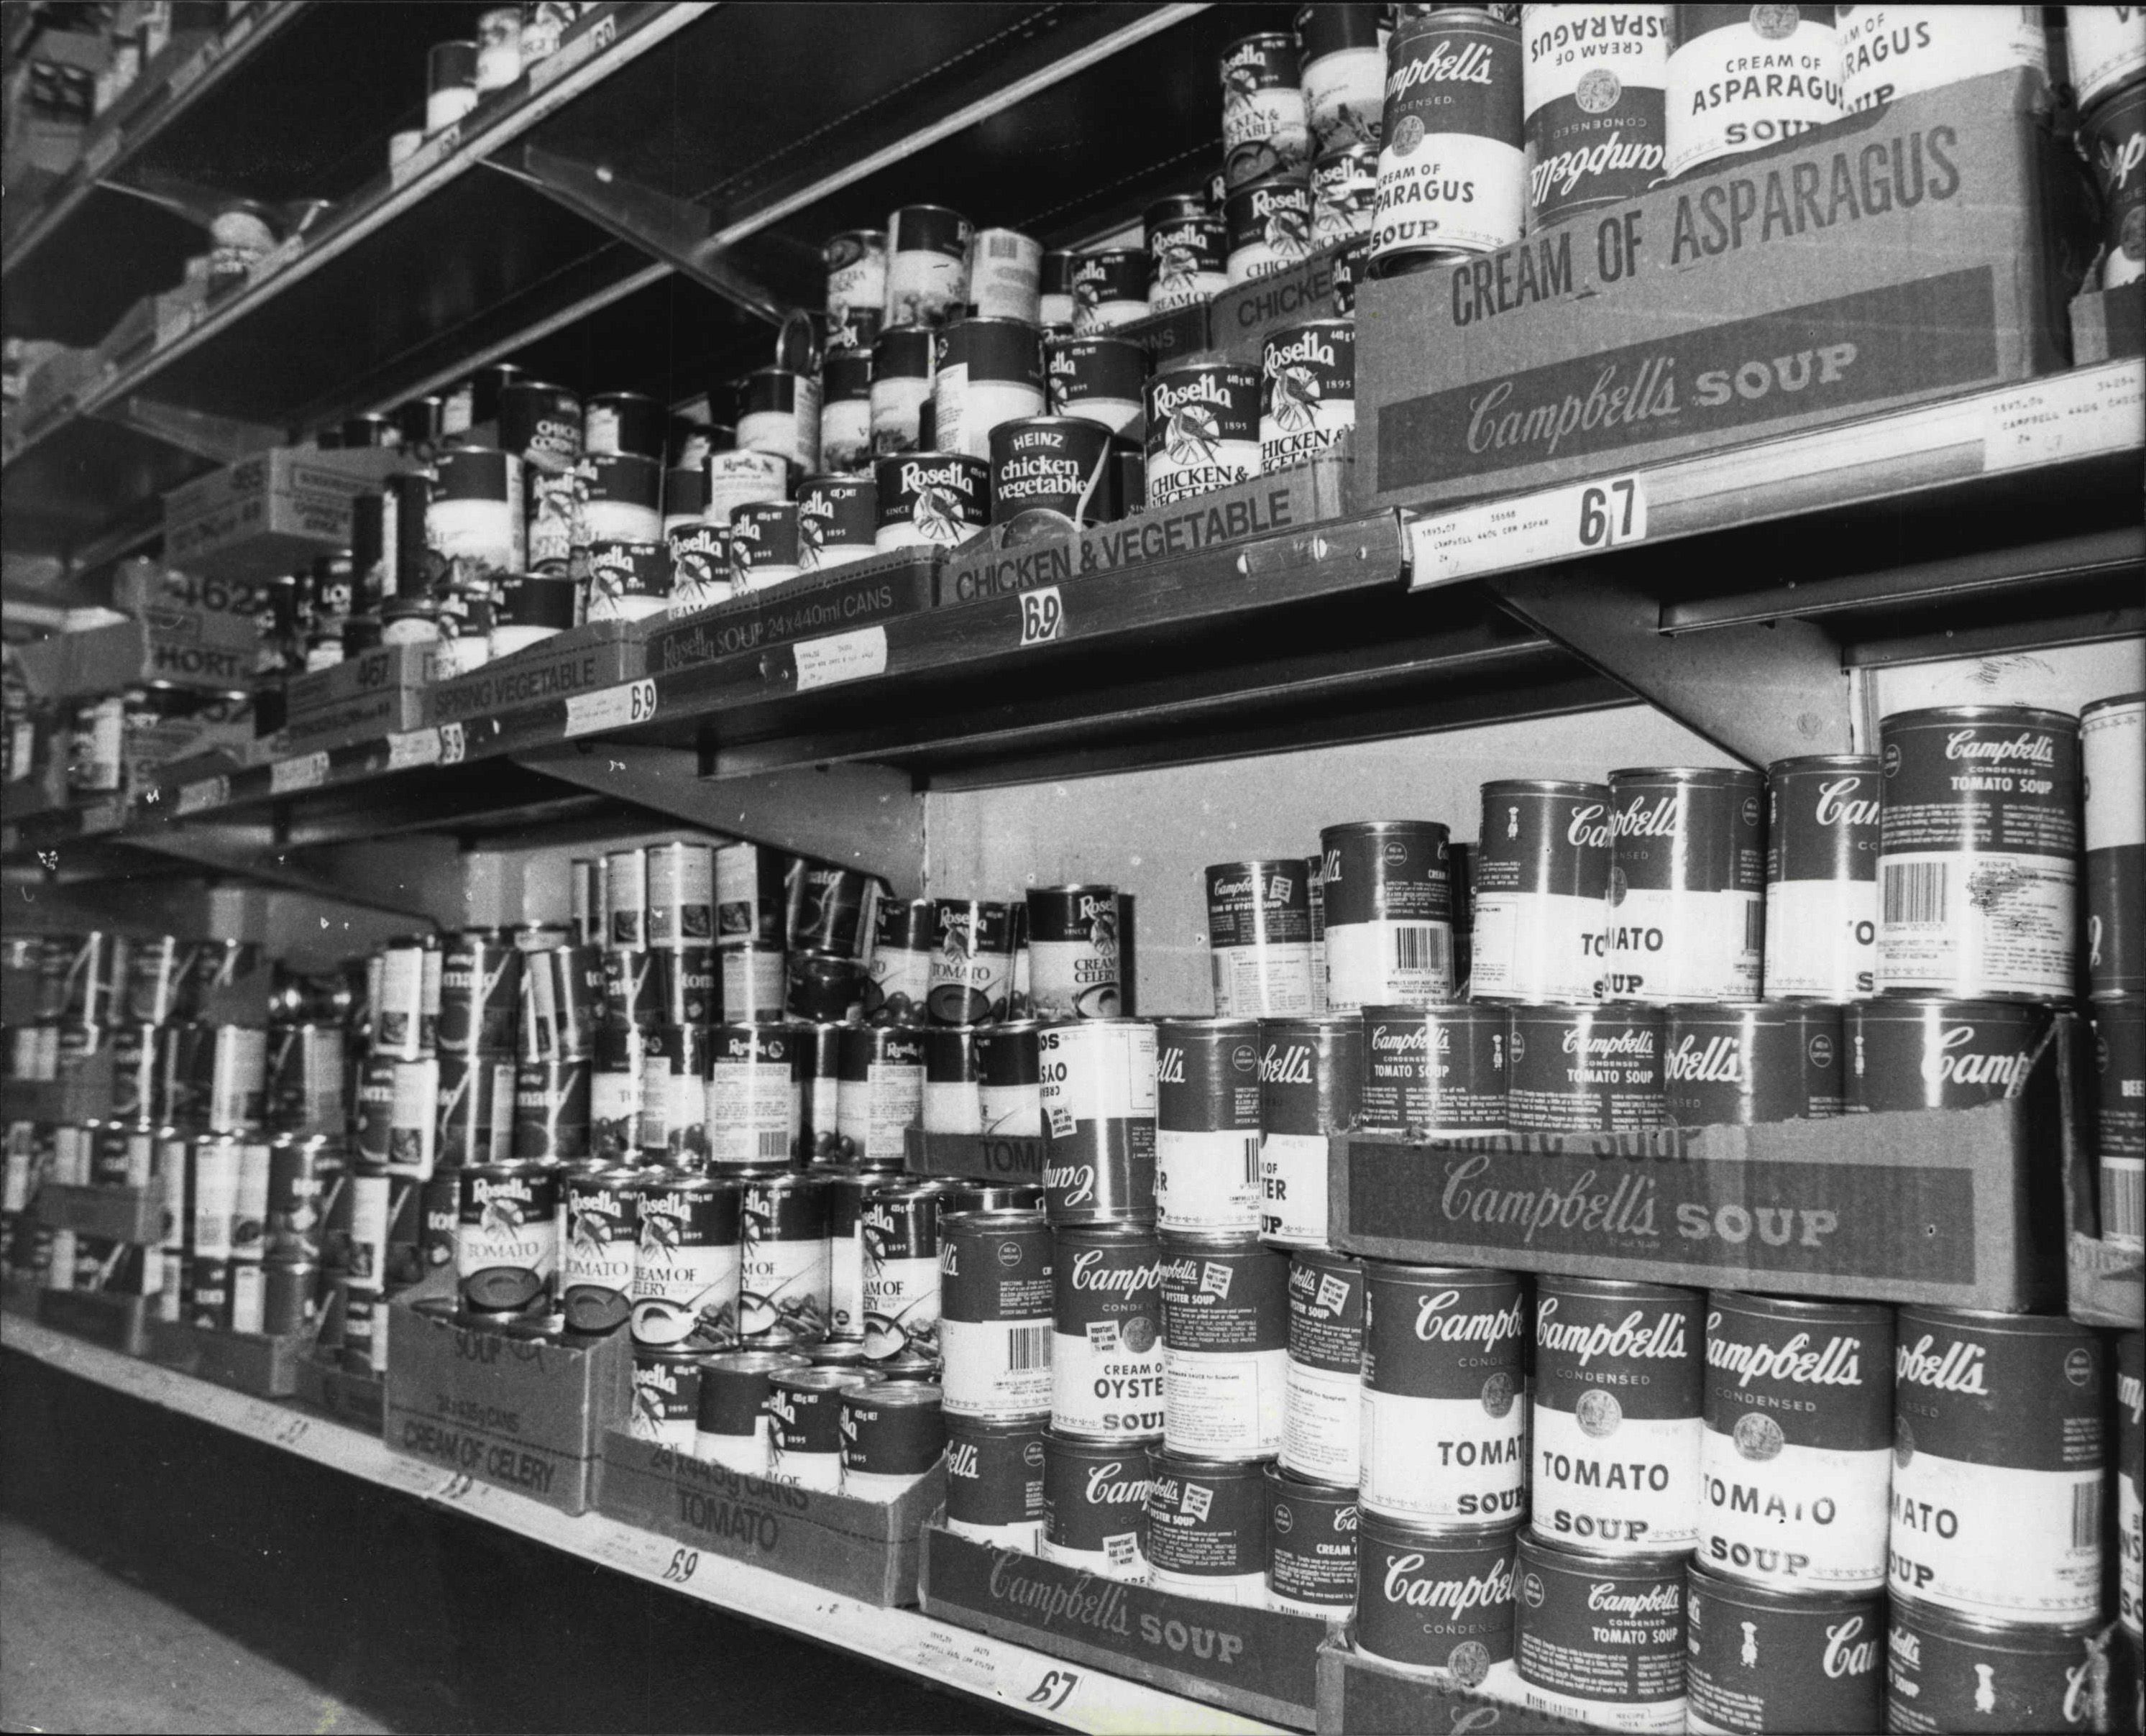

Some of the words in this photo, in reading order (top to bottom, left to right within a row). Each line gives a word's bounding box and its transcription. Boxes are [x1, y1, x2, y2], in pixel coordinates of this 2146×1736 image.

[1865, 12, 1885, 34] OF
[1554, 48, 1574, 67] OF
[1581, 40, 1644, 59] CREAM
[1725, 55, 1794, 73] CREAM
[1801, 55, 1822, 70] OF
[1840, 20, 1932, 83] RAGUS
[1420, 162, 1441, 178] OF
[1374, 180, 1475, 215] PARAGUS
[1151, 224, 1208, 260] Rosella
[1370, 220, 1441, 252] SOUP
[1451, 231, 1574, 328] CREAM
[1596, 209, 1643, 284] OF
[1669, 124, 1961, 266] ASPARAGUS
[1263, 331, 1336, 380] Rosella
[1152, 373, 1233, 423] Rosella
[1326, 380, 1352, 390] 1895
[1466, 357, 1682, 455] Campbell's
[1692, 342, 1858, 406] SOUP
[1013, 431, 1064, 451] HEINZ
[1224, 422, 1247, 431] 1895
[900, 461, 974, 496] Rosella
[1000, 455, 1080, 482] chicken
[1151, 466, 1232, 498] CHICKEN
[1234, 466, 1250, 482] &
[997, 475, 1088, 501] vegetable
[885, 505, 911, 517] SINCE
[1578, 477, 1638, 546] 67
[955, 544, 1073, 605] CHICKEN
[1078, 541, 1099, 575] &
[1101, 487, 1293, 570] VEGETABLE
[843, 585, 894, 619] CANS
[1023, 594, 1060, 642] 69
[492, 656, 597, 705] VEGETABLE
[630, 681, 656, 721] 69
[1944, 728, 2056, 765] Campbell's
[1949, 776, 2014, 793] TOMATO
[2019, 778, 2053, 795] SOUP
[1562, 1027, 1655, 1058] Campbell's
[1374, 1063, 1413, 1079] TOMATO
[1418, 1065, 1450, 1079] SOUP
[1566, 1068, 1619, 1084] TOMATO
[1625, 1068, 1655, 1085] SOUP
[472, 1177, 533, 1204] Rosella
[569, 1188, 623, 1219] Rosella
[1440, 1154, 1661, 1244] Campbell's
[1675, 1202, 1839, 1248] SOUP
[636, 1191, 692, 1223] Rosella
[674, 1268, 698, 1283] OF
[756, 1262, 776, 1276] OF
[882, 1281, 905, 1295] OF
[1191, 1294, 1216, 1305] SOUP
[1536, 1295, 1689, 1367] Campbell's
[1103, 1361, 1152, 1376] CREAM
[1555, 1368, 1651, 1387] CONDENSED
[1542, 1451, 1670, 1493] TOMATO
[678, 1487, 779, 1553] TOMATO
[1554, 1509, 1649, 1543] SOUP
[1316, 1543, 1352, 1556] CREAM
[1710, 1535, 1811, 1577] SOUP
[1587, 1581, 1680, 1619] Campbell's
[1139, 1615, 1245, 1666] SOUP
[1591, 1626, 1648, 1645] TOMATO
[1652, 1627, 1679, 1644] SOUP
[1024, 1669, 1080, 1712] 67
